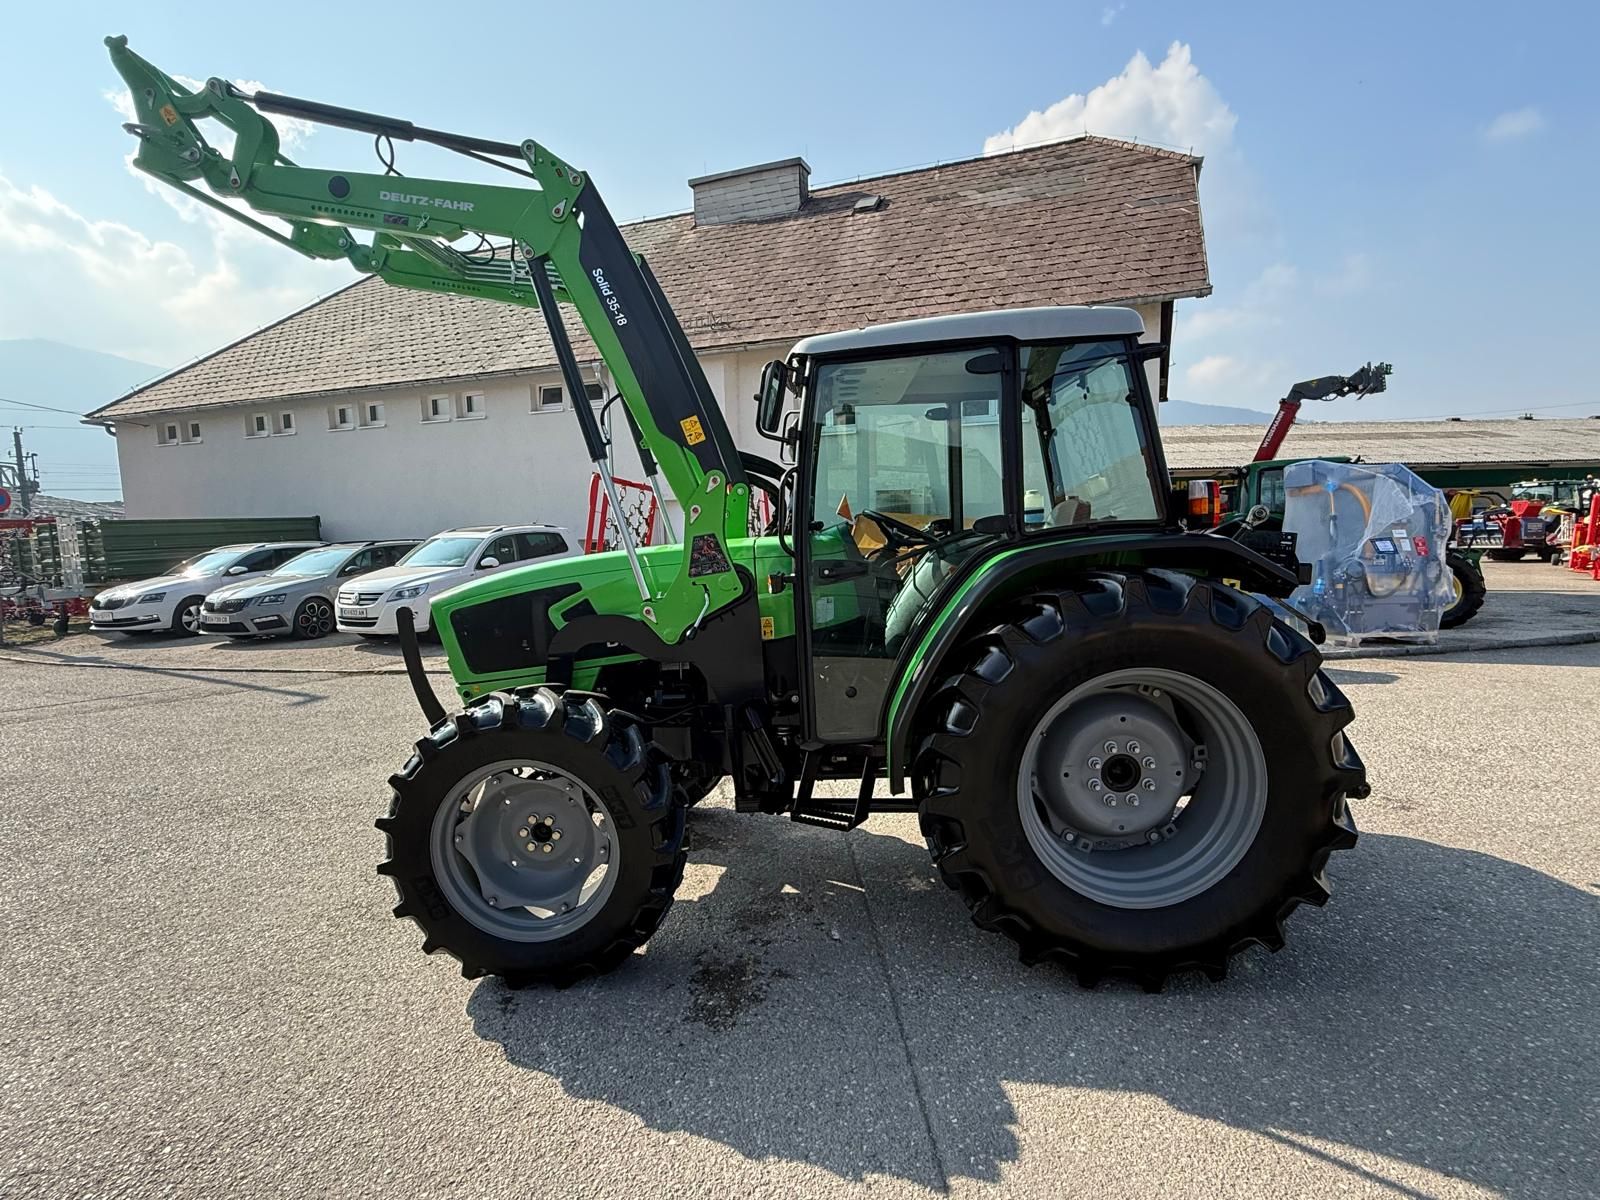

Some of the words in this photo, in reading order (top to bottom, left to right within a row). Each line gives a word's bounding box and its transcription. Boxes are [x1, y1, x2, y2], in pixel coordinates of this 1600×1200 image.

[379, 190, 475, 212] DEUTZ-FAHR
[592, 267, 614, 297] Solid
[606, 296, 628, 326] 35-18
